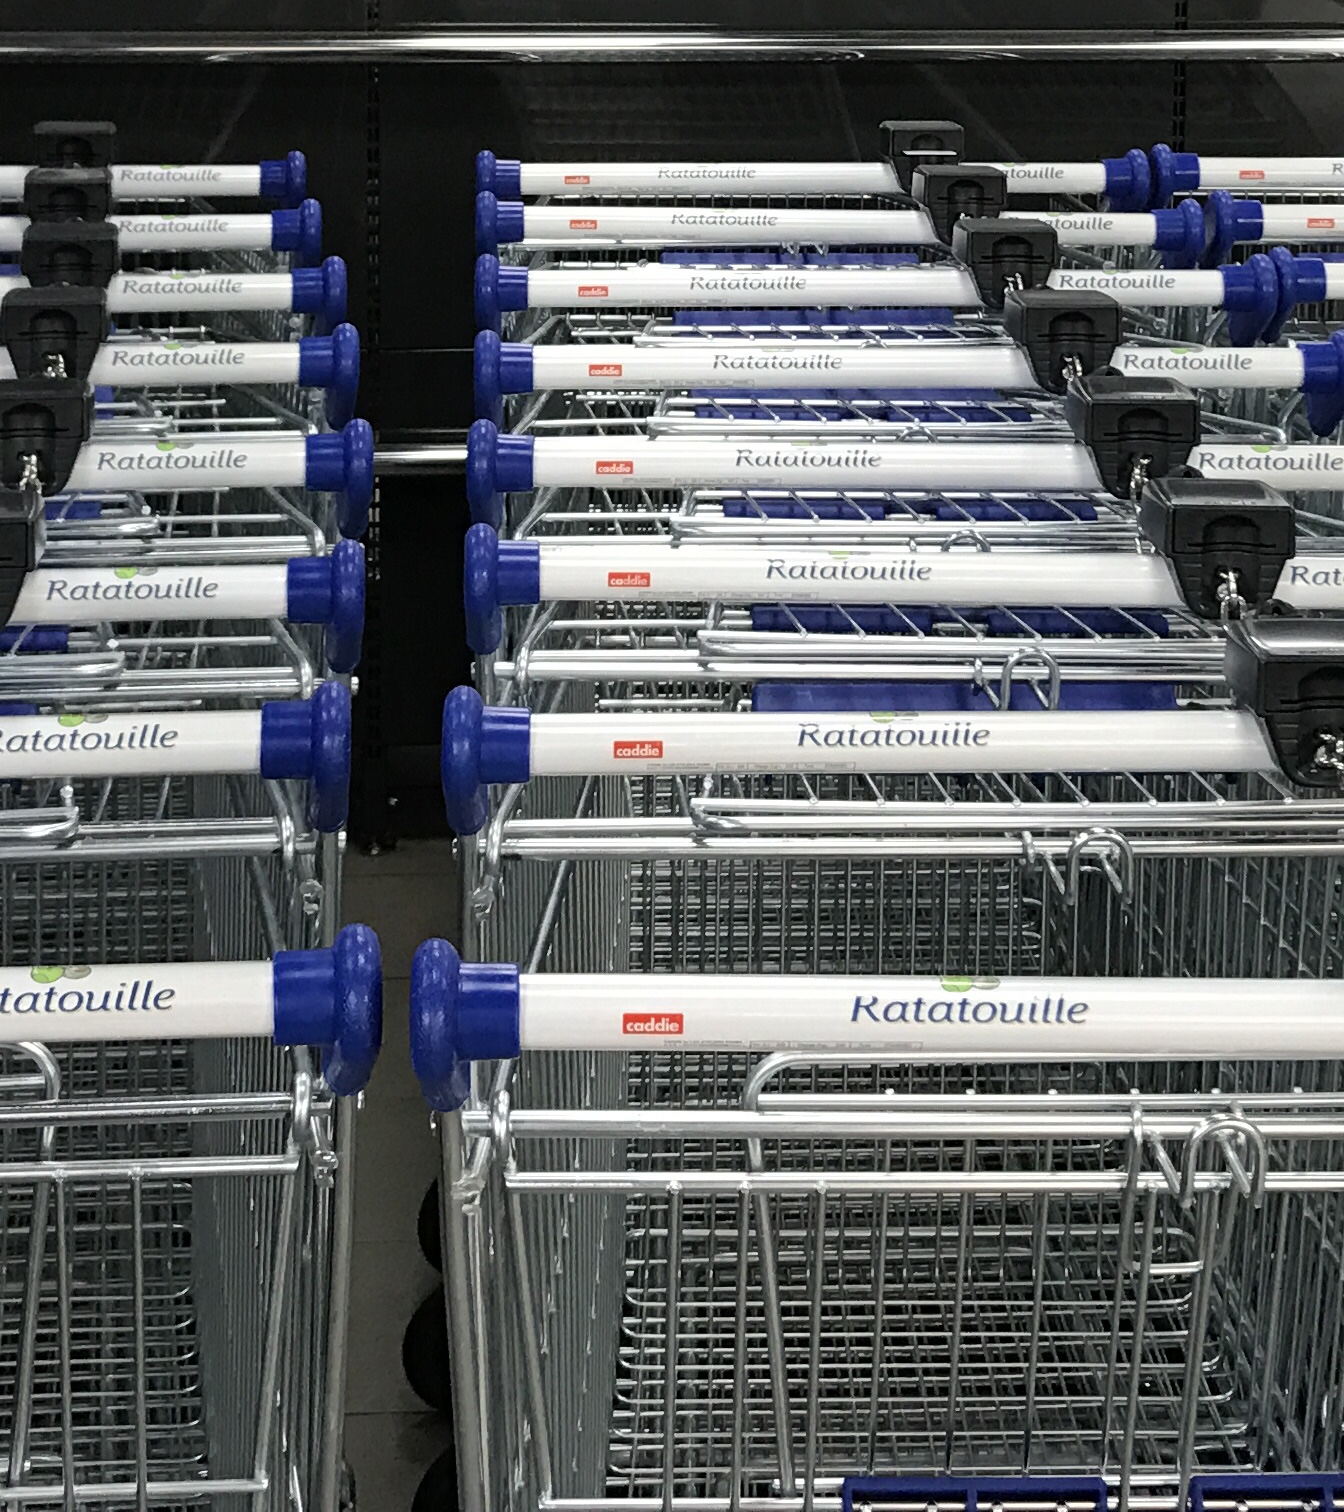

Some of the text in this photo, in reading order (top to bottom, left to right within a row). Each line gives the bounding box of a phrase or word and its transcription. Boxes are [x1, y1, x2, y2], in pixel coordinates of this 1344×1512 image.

[119, 218, 229, 234] Ratatouille
[123, 278, 242, 295] Ratatouille
[1059, 272, 1176, 290] Ratatouille
[112, 348, 244, 366] Ratatouille
[1123, 351, 1253, 371] Ratatouille
[591, 366, 620, 375] caddie
[97, 450, 247, 472] Ratatouille
[598, 464, 631, 472] caddie
[1197, 449, 1344, 474] Ratatouille
[611, 575, 648, 586] caddie
[46, 577, 218, 602] Ratatouille
[616, 744, 660, 757] caddie
[850, 990, 1089, 1028] Ratatouille
[626, 1018, 680, 1033] caddie
